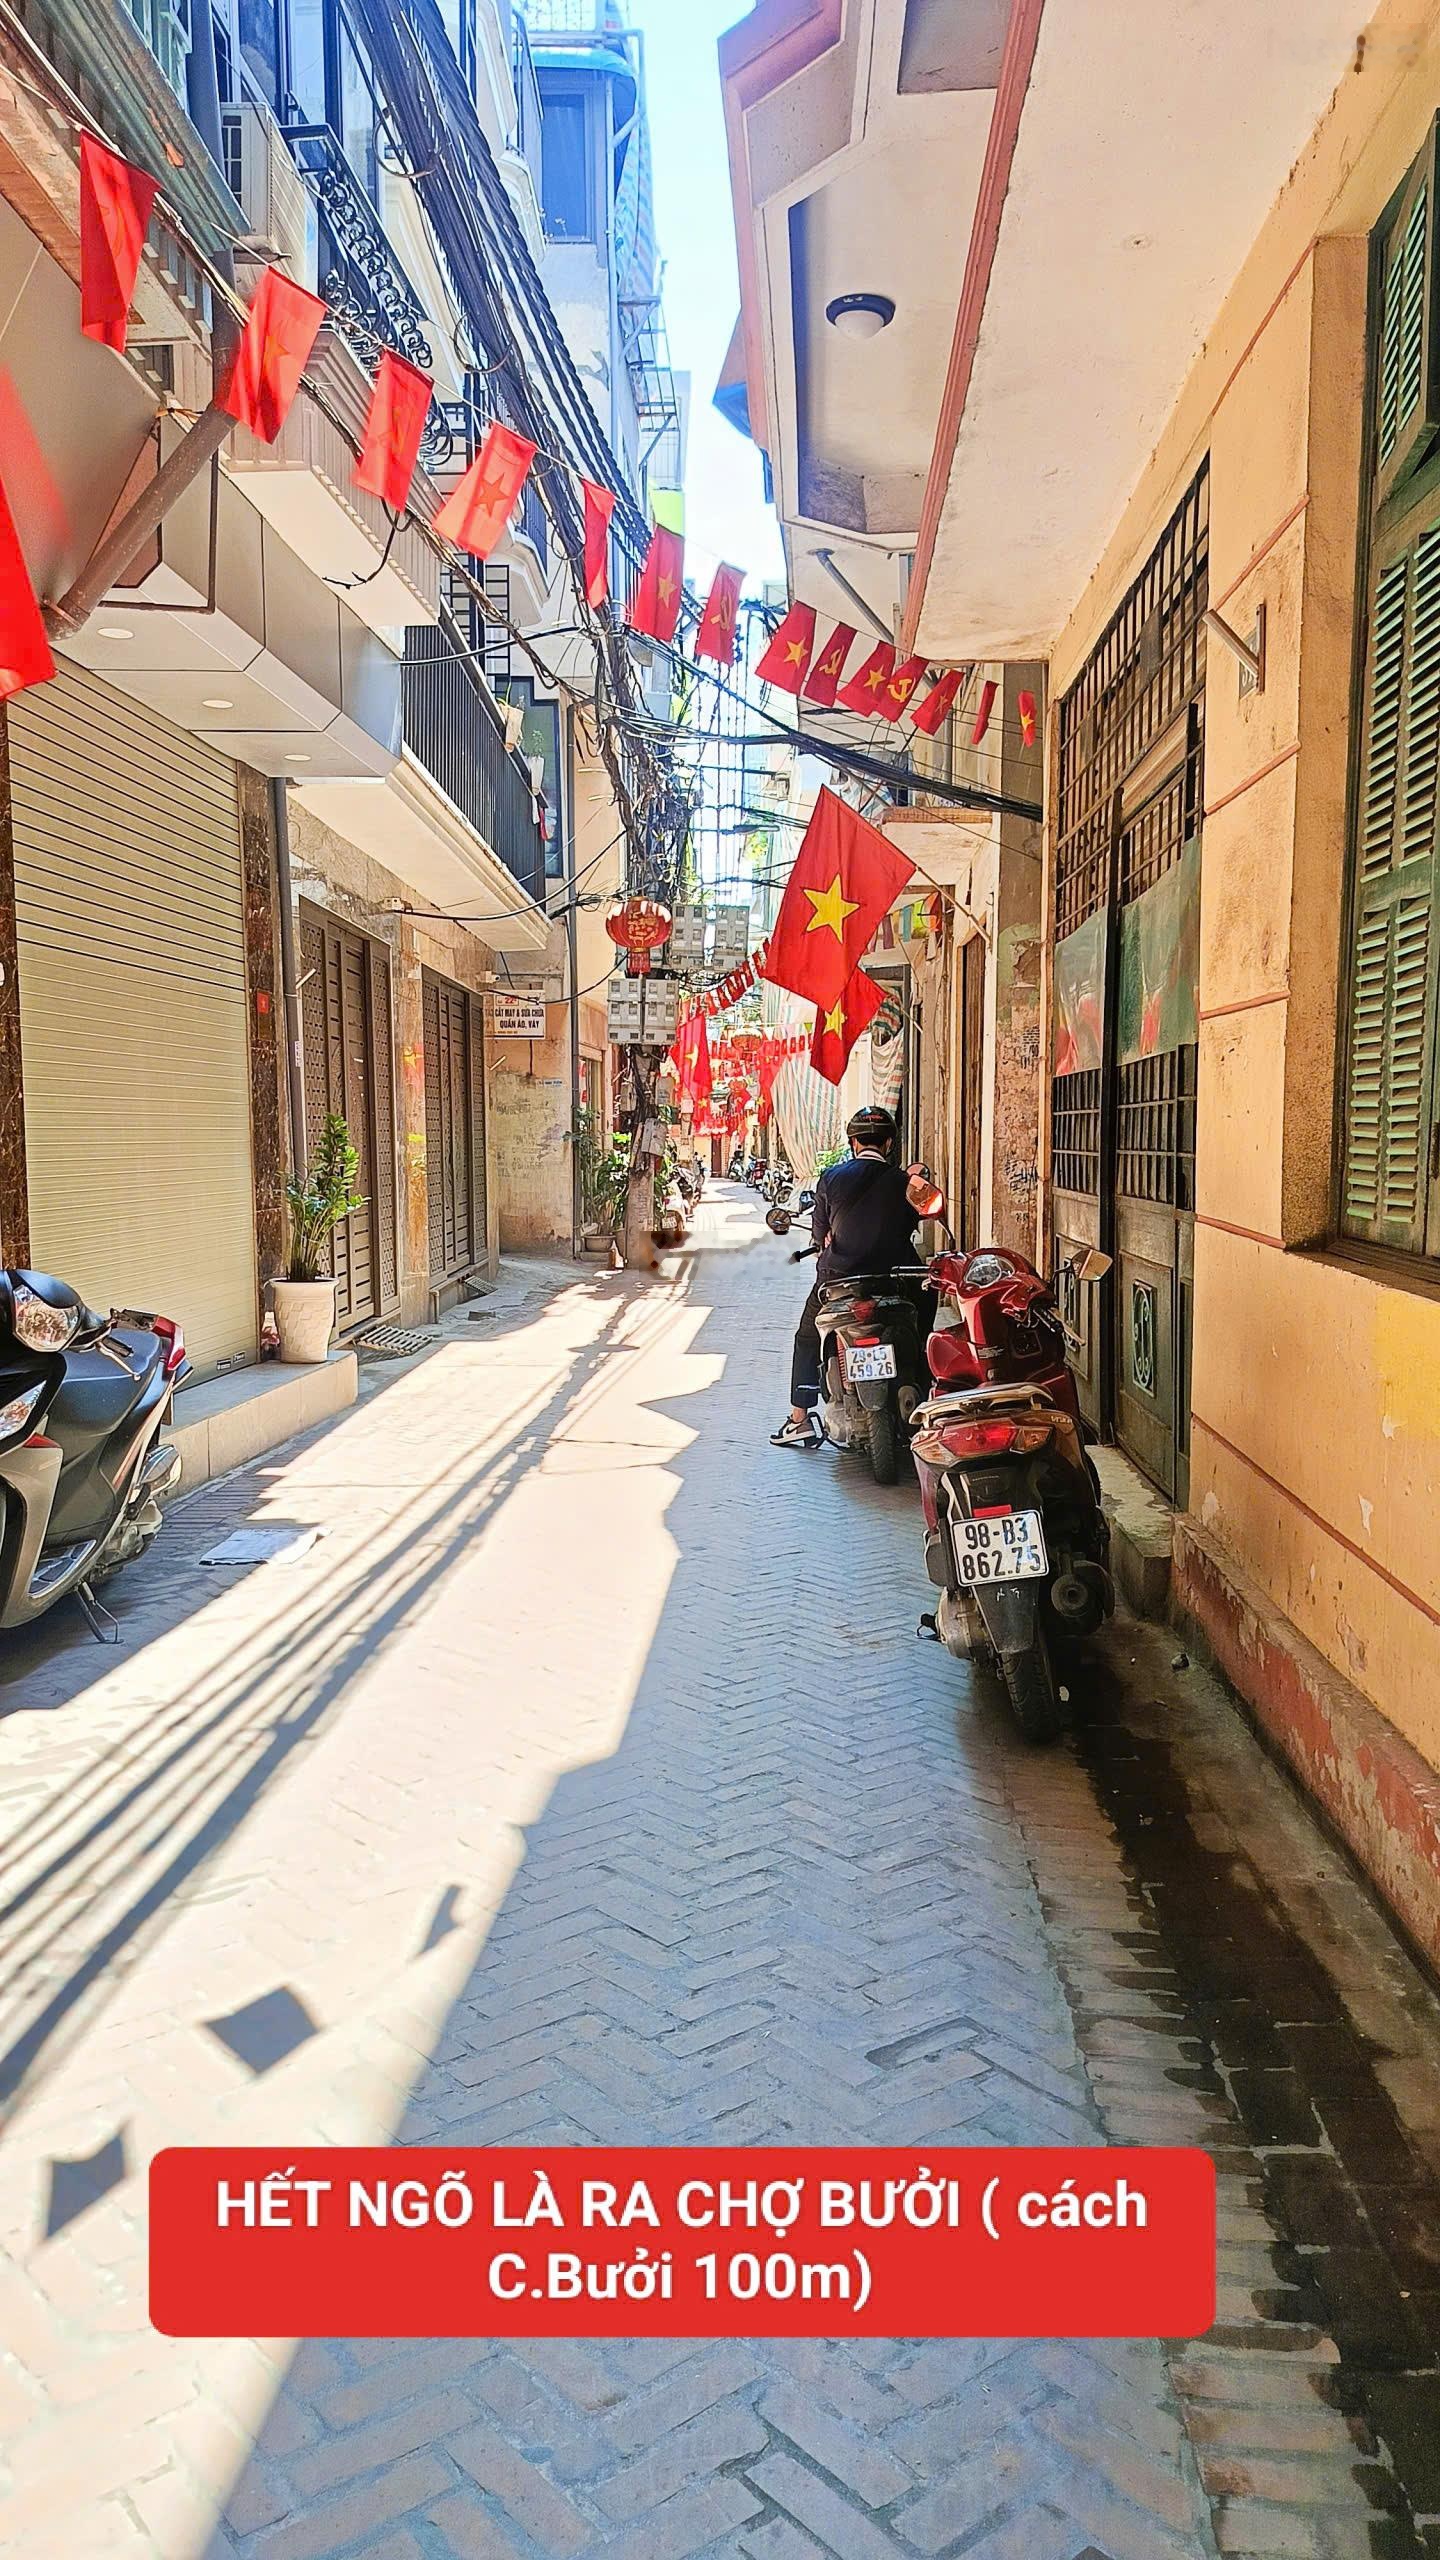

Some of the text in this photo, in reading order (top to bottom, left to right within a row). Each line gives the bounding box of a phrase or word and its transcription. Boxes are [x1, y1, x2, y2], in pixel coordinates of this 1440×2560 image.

[850, 1361, 893, 1378] 459.26
[965, 1517, 1029, 1550] 98-B3
[962, 1544, 1041, 1580] 862.75
